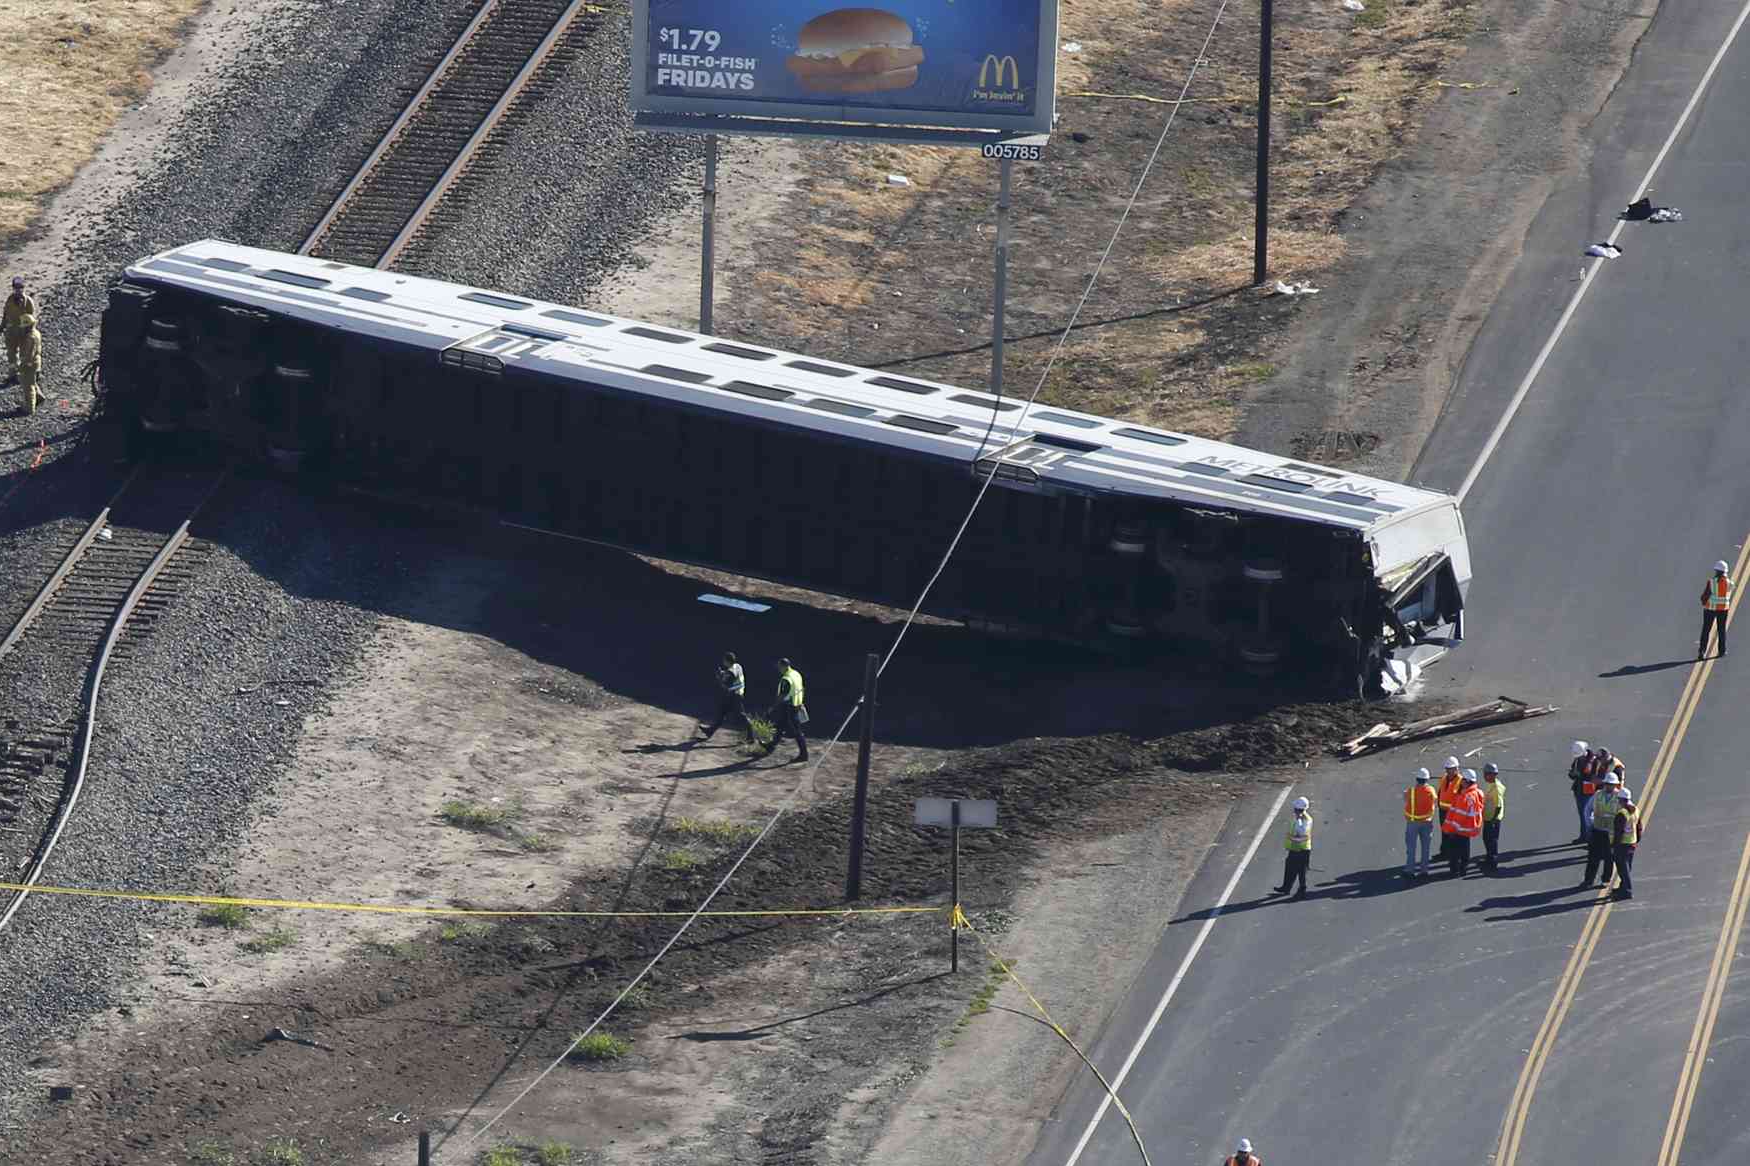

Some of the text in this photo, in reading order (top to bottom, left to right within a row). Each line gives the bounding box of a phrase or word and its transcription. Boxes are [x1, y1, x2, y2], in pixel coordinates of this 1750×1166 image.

[659, 26, 722, 52] $1.79
[658, 53, 755, 70] FILET-O-FISH
[657, 68, 755, 90] FRIDAYS
[983, 144, 1039, 160] 005785
[1198, 455, 1394, 497] METROLINK
